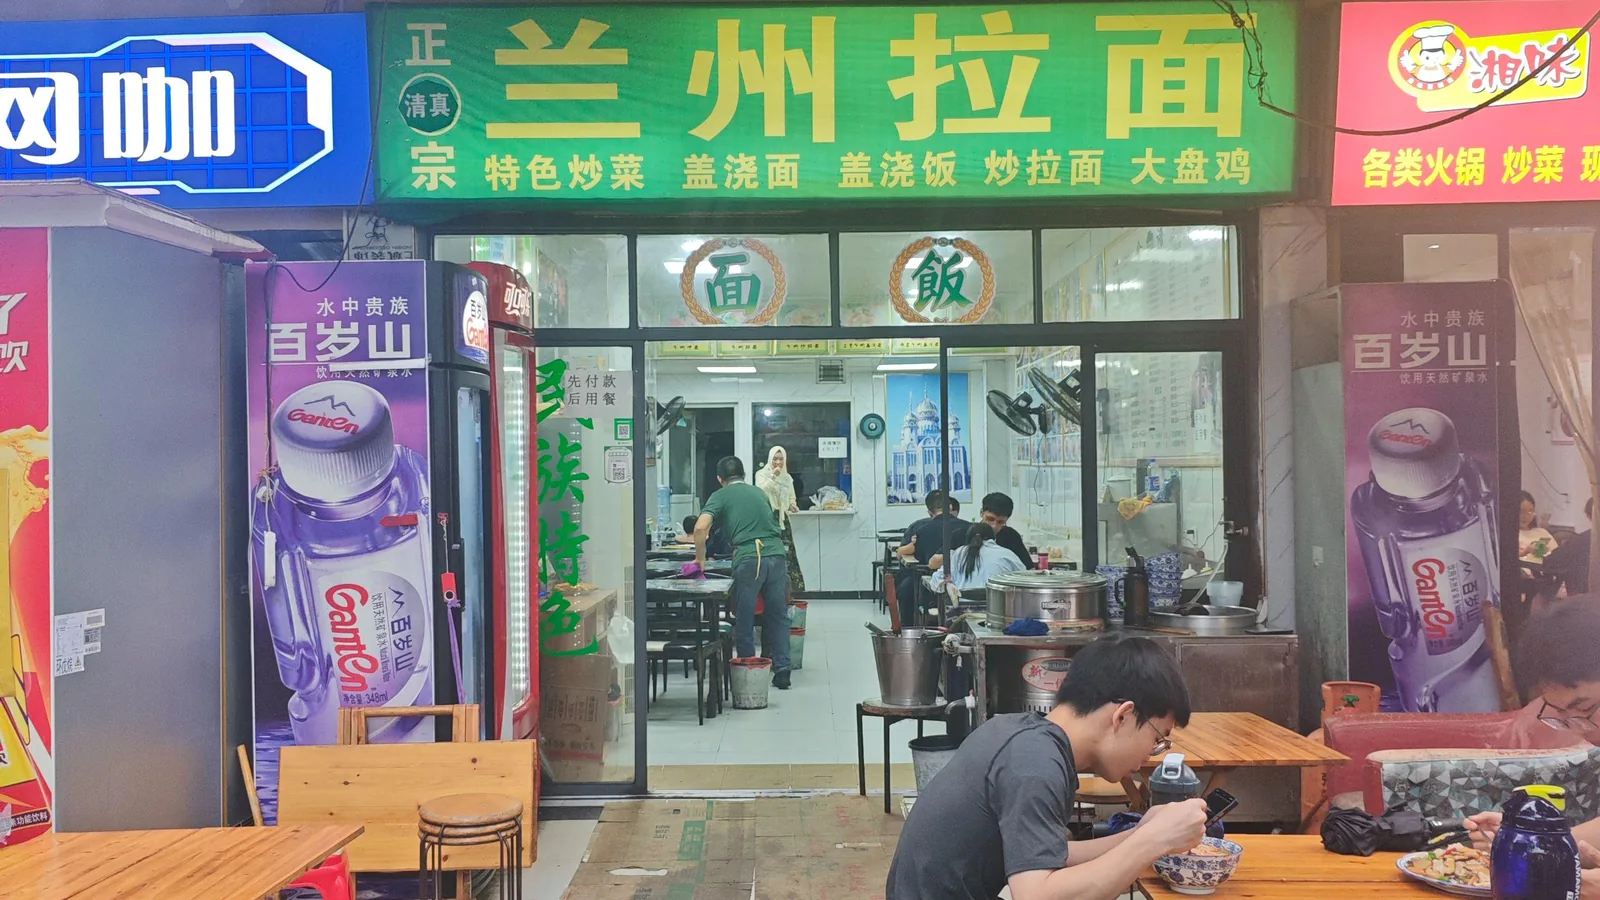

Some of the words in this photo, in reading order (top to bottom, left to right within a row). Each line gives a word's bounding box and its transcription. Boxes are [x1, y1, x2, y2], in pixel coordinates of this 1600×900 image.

[405, 22, 451, 66] 正
[1469, 37, 1577, 91] 湘味
[485, 10, 1257, 143] 兰州拉面
[404, 93, 451, 119] 清真
[411, 141, 455, 191] 宗
[484, 154, 645, 191] 特色炒菜
[682, 153, 800, 190] 盖浇面
[838, 151, 957, 188] 盖浇饭
[984, 149, 1104, 186] 炒拉面
[1131, 147, 1251, 185] 大盘鸡
[1362, 147, 1486, 188] 各类火锅
[1502, 145, 1565, 184] 炒菜
[706, 253, 761, 314] 面
[911, 249, 974, 311] 飯
[316, 296, 409, 317] 水中贵族
[1401, 310, 1485, 328] 水中贵族
[265, 321, 411, 362] 百岁山
[1353, 332, 1487, 369] 百岁山
[567, 374, 616, 388] 先付款
[567, 391, 616, 407] 后用餐
[1400, 372, 1488, 385] 饮用天然矿泉水
[1462, 580, 1481, 622] 百岁山
[391, 614, 414, 671] 百岁山
